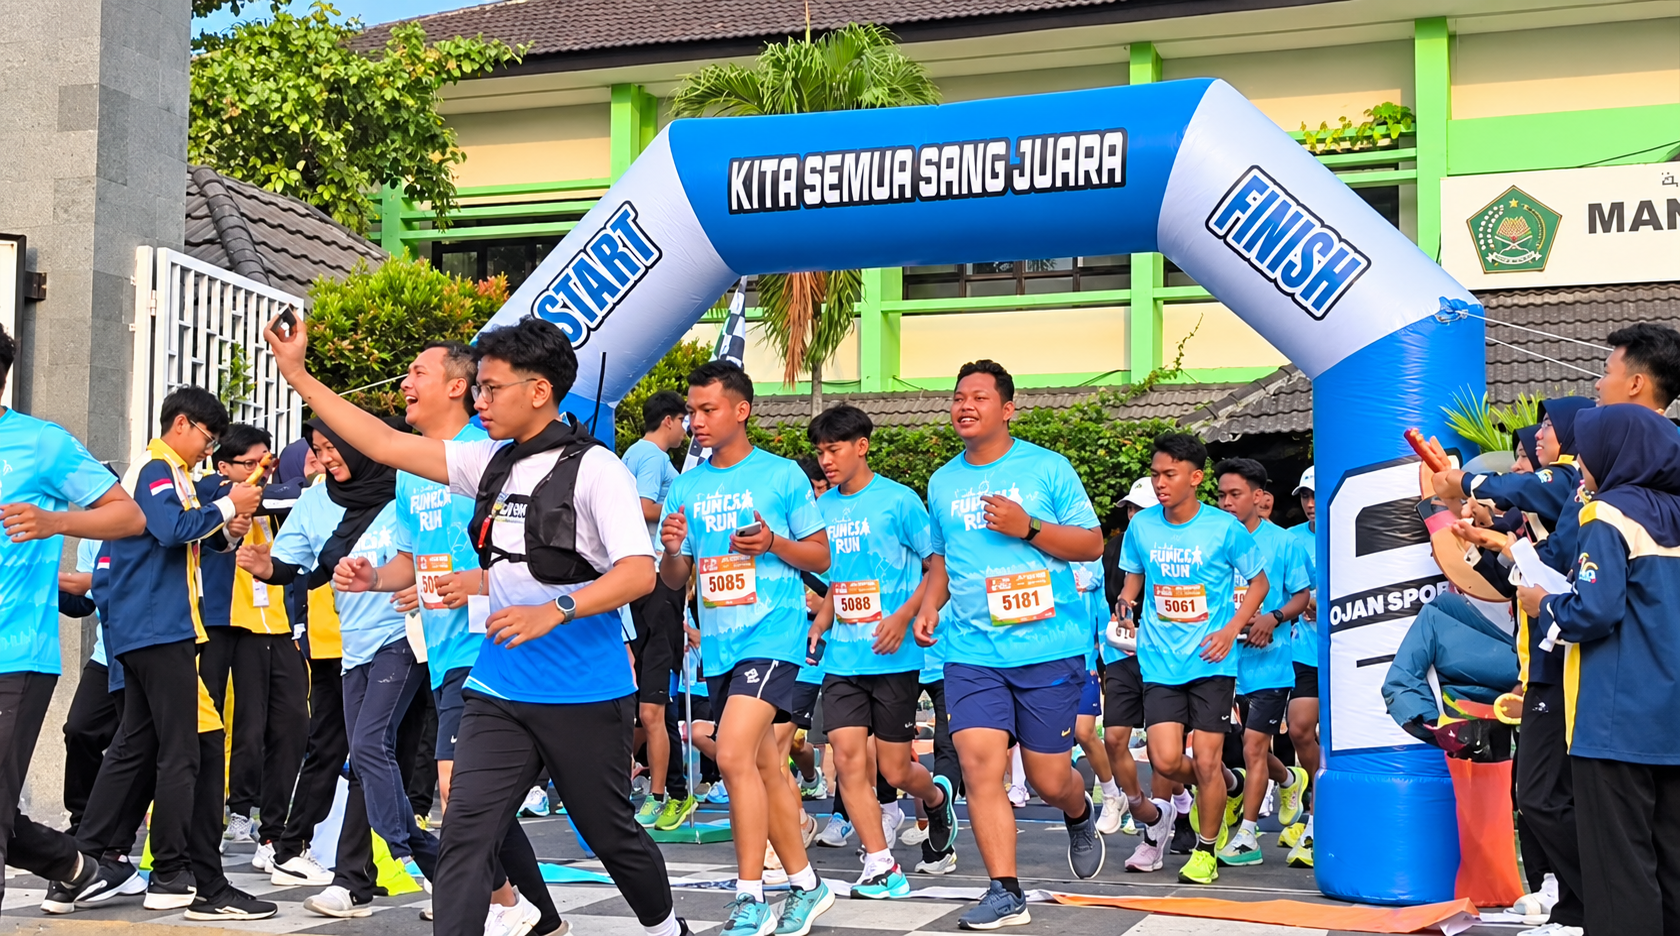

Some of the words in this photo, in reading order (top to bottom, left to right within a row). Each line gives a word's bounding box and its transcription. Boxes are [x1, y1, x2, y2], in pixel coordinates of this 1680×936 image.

[730, 156, 798, 211] KITA
[802, 148, 913, 206] SEMUA
[918, 140, 1007, 198] SANG
[1012, 131, 1123, 191] JUARA
[1210, 170, 1366, 316] FINISH
[534, 205, 659, 347] START
[705, 511, 737, 533] RUN
[836, 536, 861, 554] RUN
[1160, 563, 1190, 578] RUN
[708, 573, 746, 593] 5085
[840, 596, 871, 612] 5088
[1002, 589, 1040, 611] 5181
[1164, 599, 1196, 613] 5061
